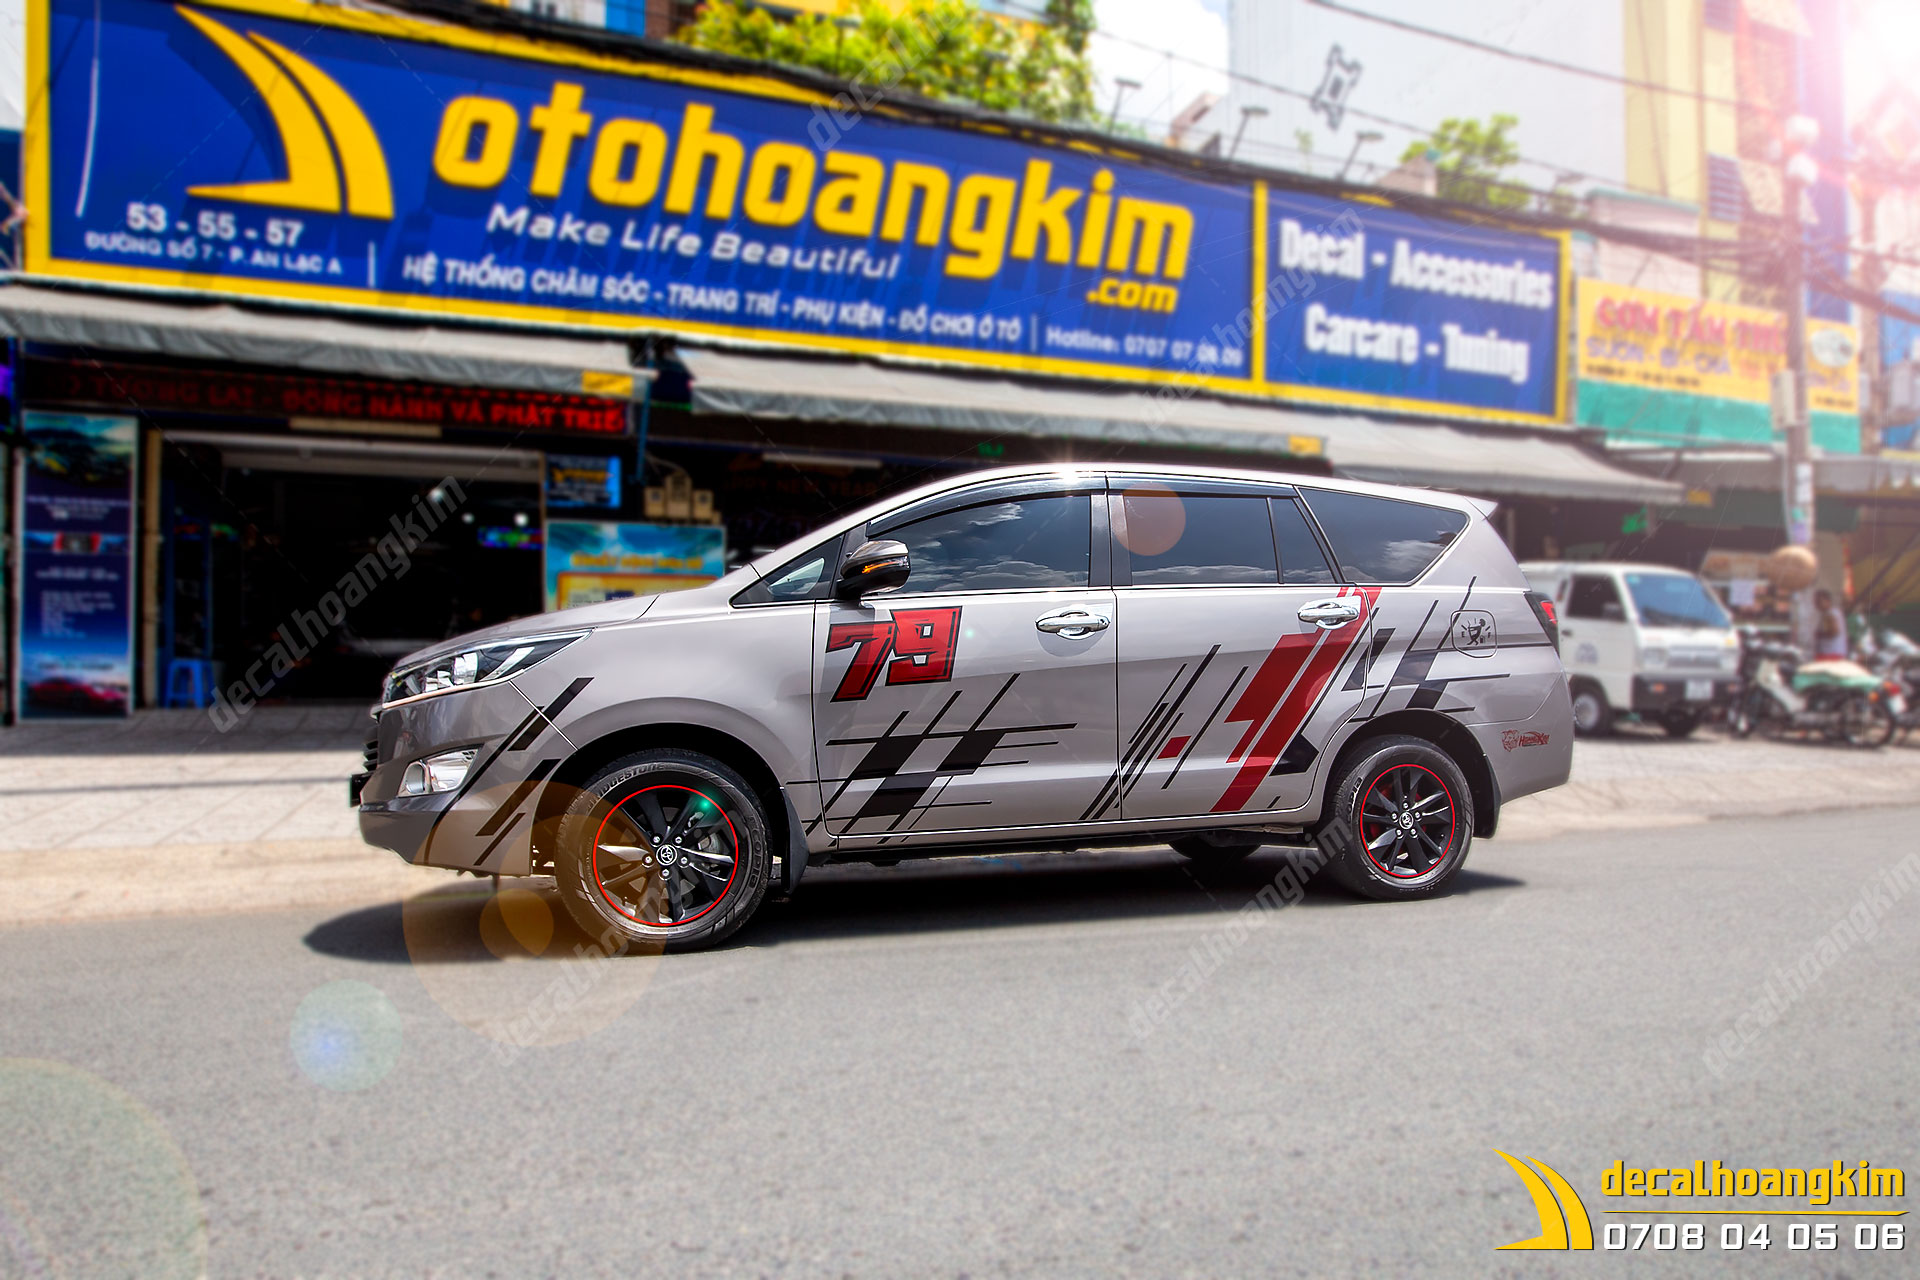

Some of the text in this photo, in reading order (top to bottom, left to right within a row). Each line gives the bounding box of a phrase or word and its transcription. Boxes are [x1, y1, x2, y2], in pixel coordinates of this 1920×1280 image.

[434, 80, 1193, 279] otohoangkim
[127, 202, 304, 247] 53 55 57
[201, 243, 213, 261] 7
[251, 248, 280, 268] AN
[326, 257, 342, 275] A
[486, 203, 901, 279] Make Life Beautiful
[1279, 218, 1553, 309] Decal Accessories
[403, 251, 438, 285] HỆ
[444, 254, 525, 291] THỐNG
[530, 266, 598, 297] CHĂM
[602, 272, 650, 302] SÓC
[667, 283, 739, 312] TRANG
[744, 289, 780, 316] TRÍ
[792, 298, 835, 325] PHỤ
[839, 300, 885, 328] KIỆN
[997, 315, 1021, 342] TÔ
[1087, 277, 1178, 313] .com
[1305, 302, 1530, 384] Carcare Tuning
[826, 605, 963, 703] 79
